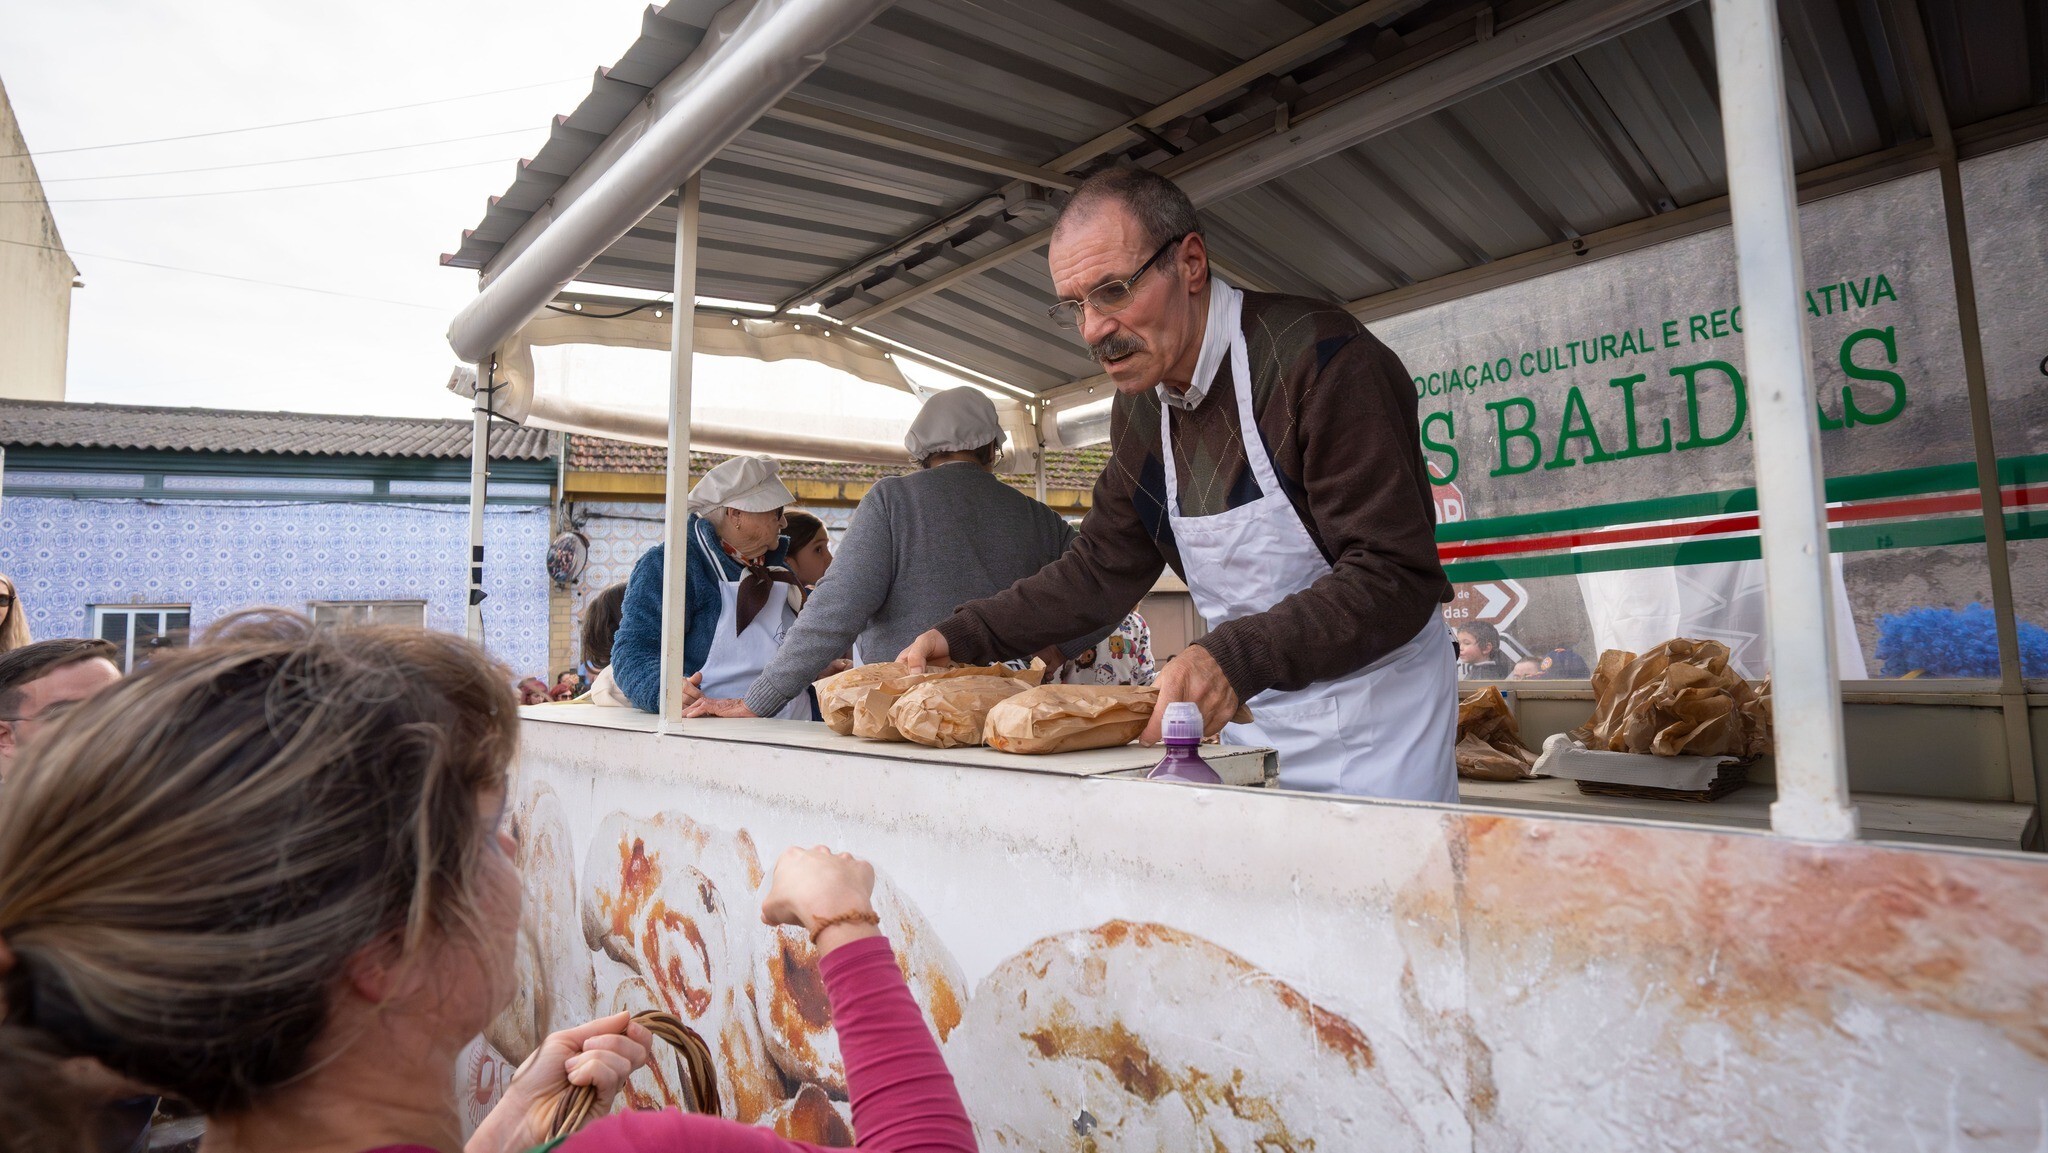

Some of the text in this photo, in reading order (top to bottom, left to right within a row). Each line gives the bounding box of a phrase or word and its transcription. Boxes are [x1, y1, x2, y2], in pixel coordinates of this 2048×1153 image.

[1520, 328, 1654, 377] CULTURAL
[1662, 320, 1680, 348] E
[1689, 274, 1898, 343] RECATIVA
[1457, 590, 1470, 599] de
